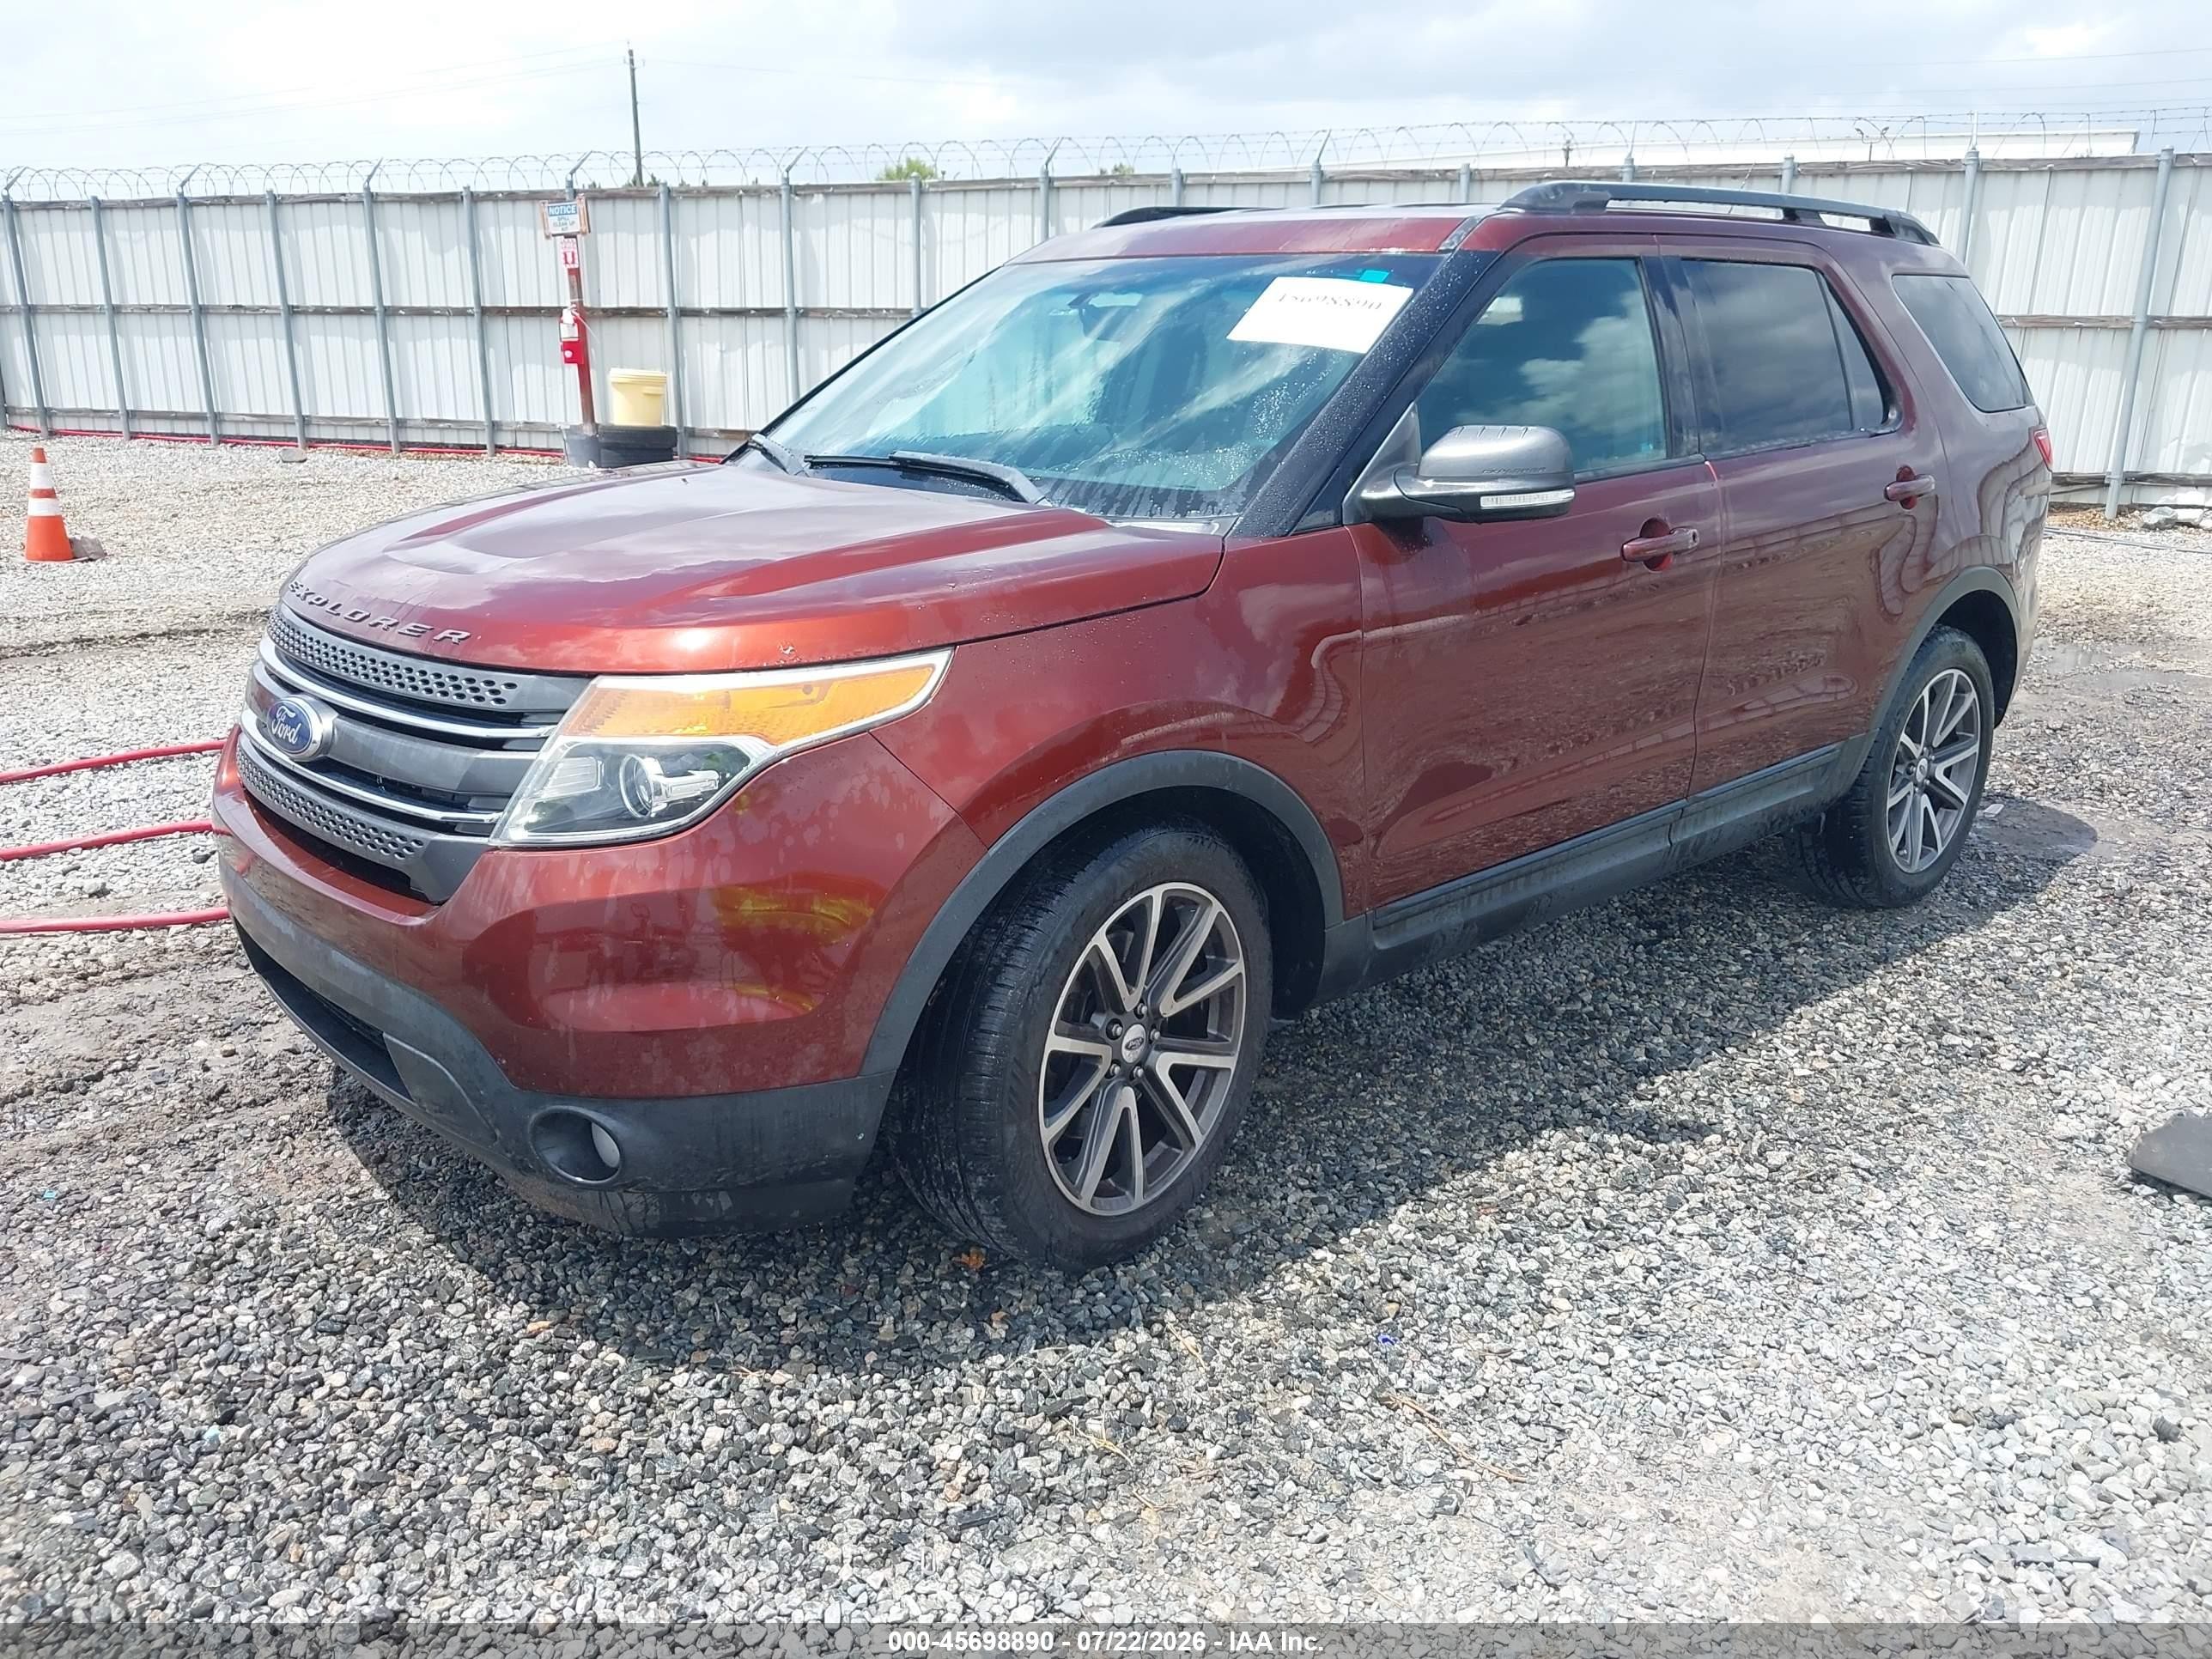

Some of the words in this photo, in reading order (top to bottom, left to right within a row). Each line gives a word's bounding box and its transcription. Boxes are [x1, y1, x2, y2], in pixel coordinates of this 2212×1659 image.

[549, 205, 577, 215] NOTICE
[288, 580, 471, 645] EXPLORER
[272, 705, 301, 744] Ford
